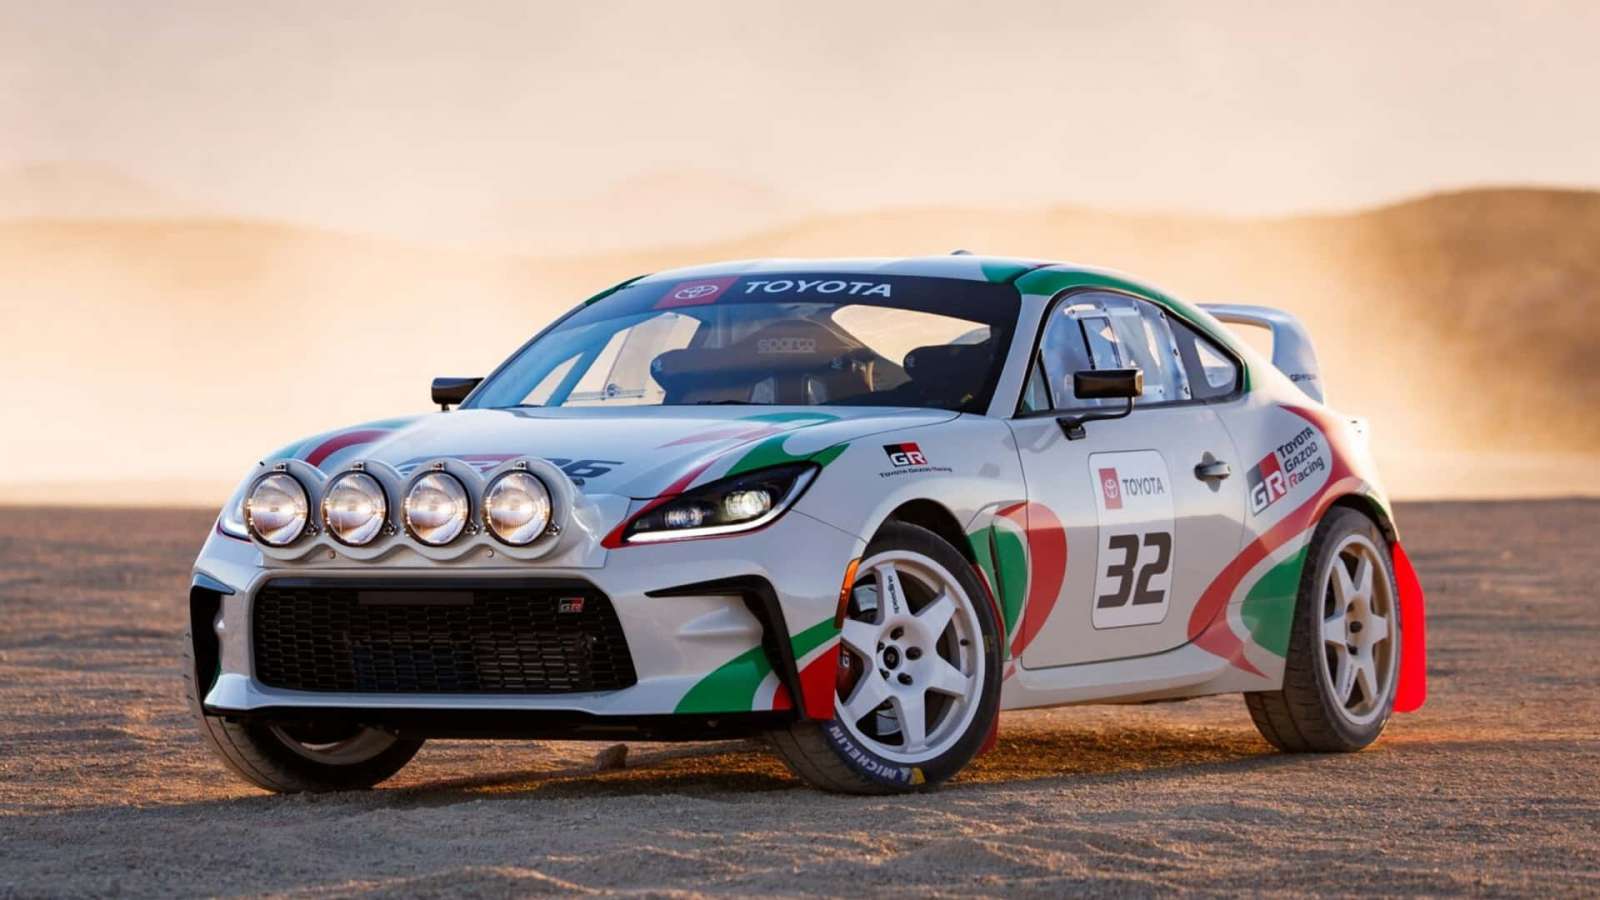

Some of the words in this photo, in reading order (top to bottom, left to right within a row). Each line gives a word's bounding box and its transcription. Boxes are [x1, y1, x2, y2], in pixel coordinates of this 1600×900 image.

[745, 279, 891, 298] TOYOTA
[891, 452, 926, 466] GR
[1277, 426, 1315, 459] TOYOTA
[1284, 441, 1318, 473] GAZOO
[1122, 478, 1165, 496] TOYOTA
[1289, 455, 1325, 489] Racing
[1250, 470, 1287, 514] GR
[1097, 532, 1172, 608] 32
[829, 726, 898, 780] MICHELIN
